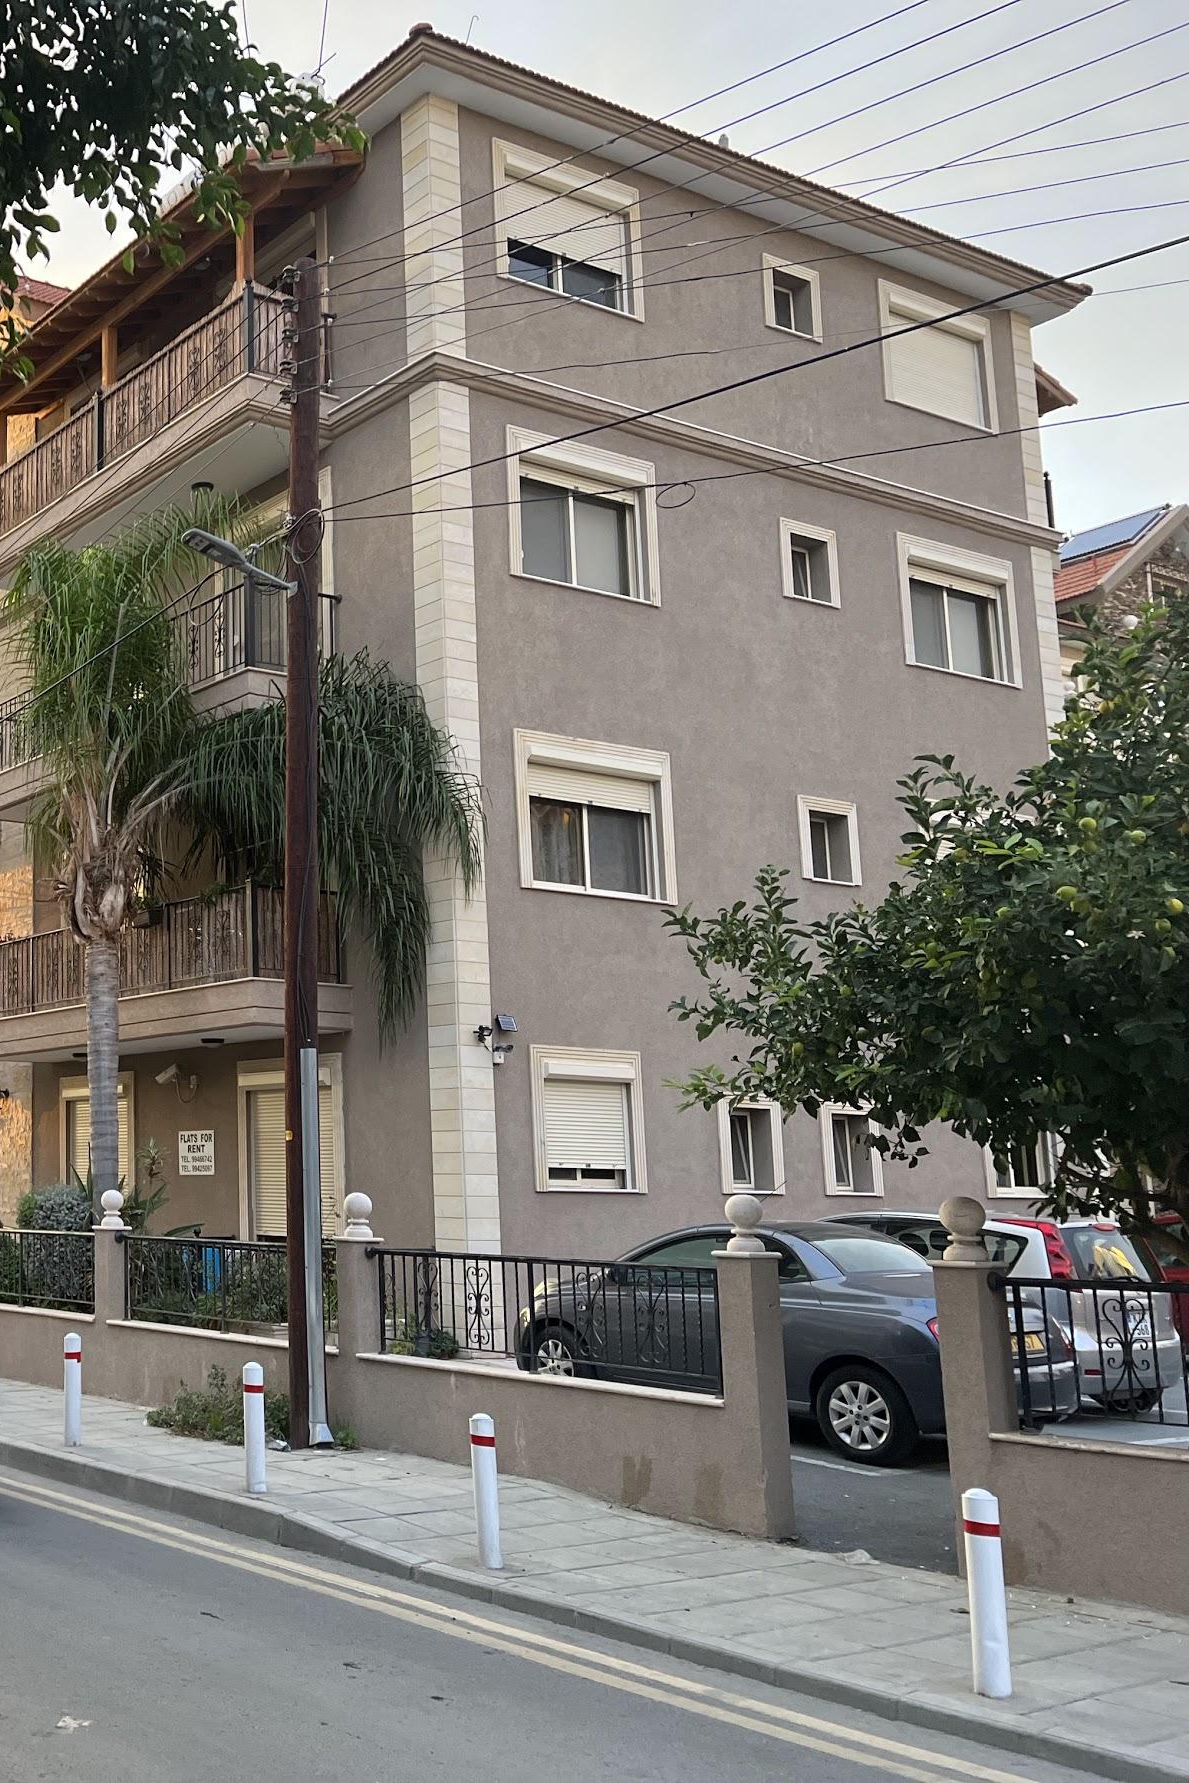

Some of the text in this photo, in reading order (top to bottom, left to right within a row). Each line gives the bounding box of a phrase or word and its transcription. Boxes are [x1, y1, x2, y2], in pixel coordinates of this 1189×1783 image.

[180, 1133, 212, 1143] FLATS FOR
[187, 1144, 205, 1153] RENT
